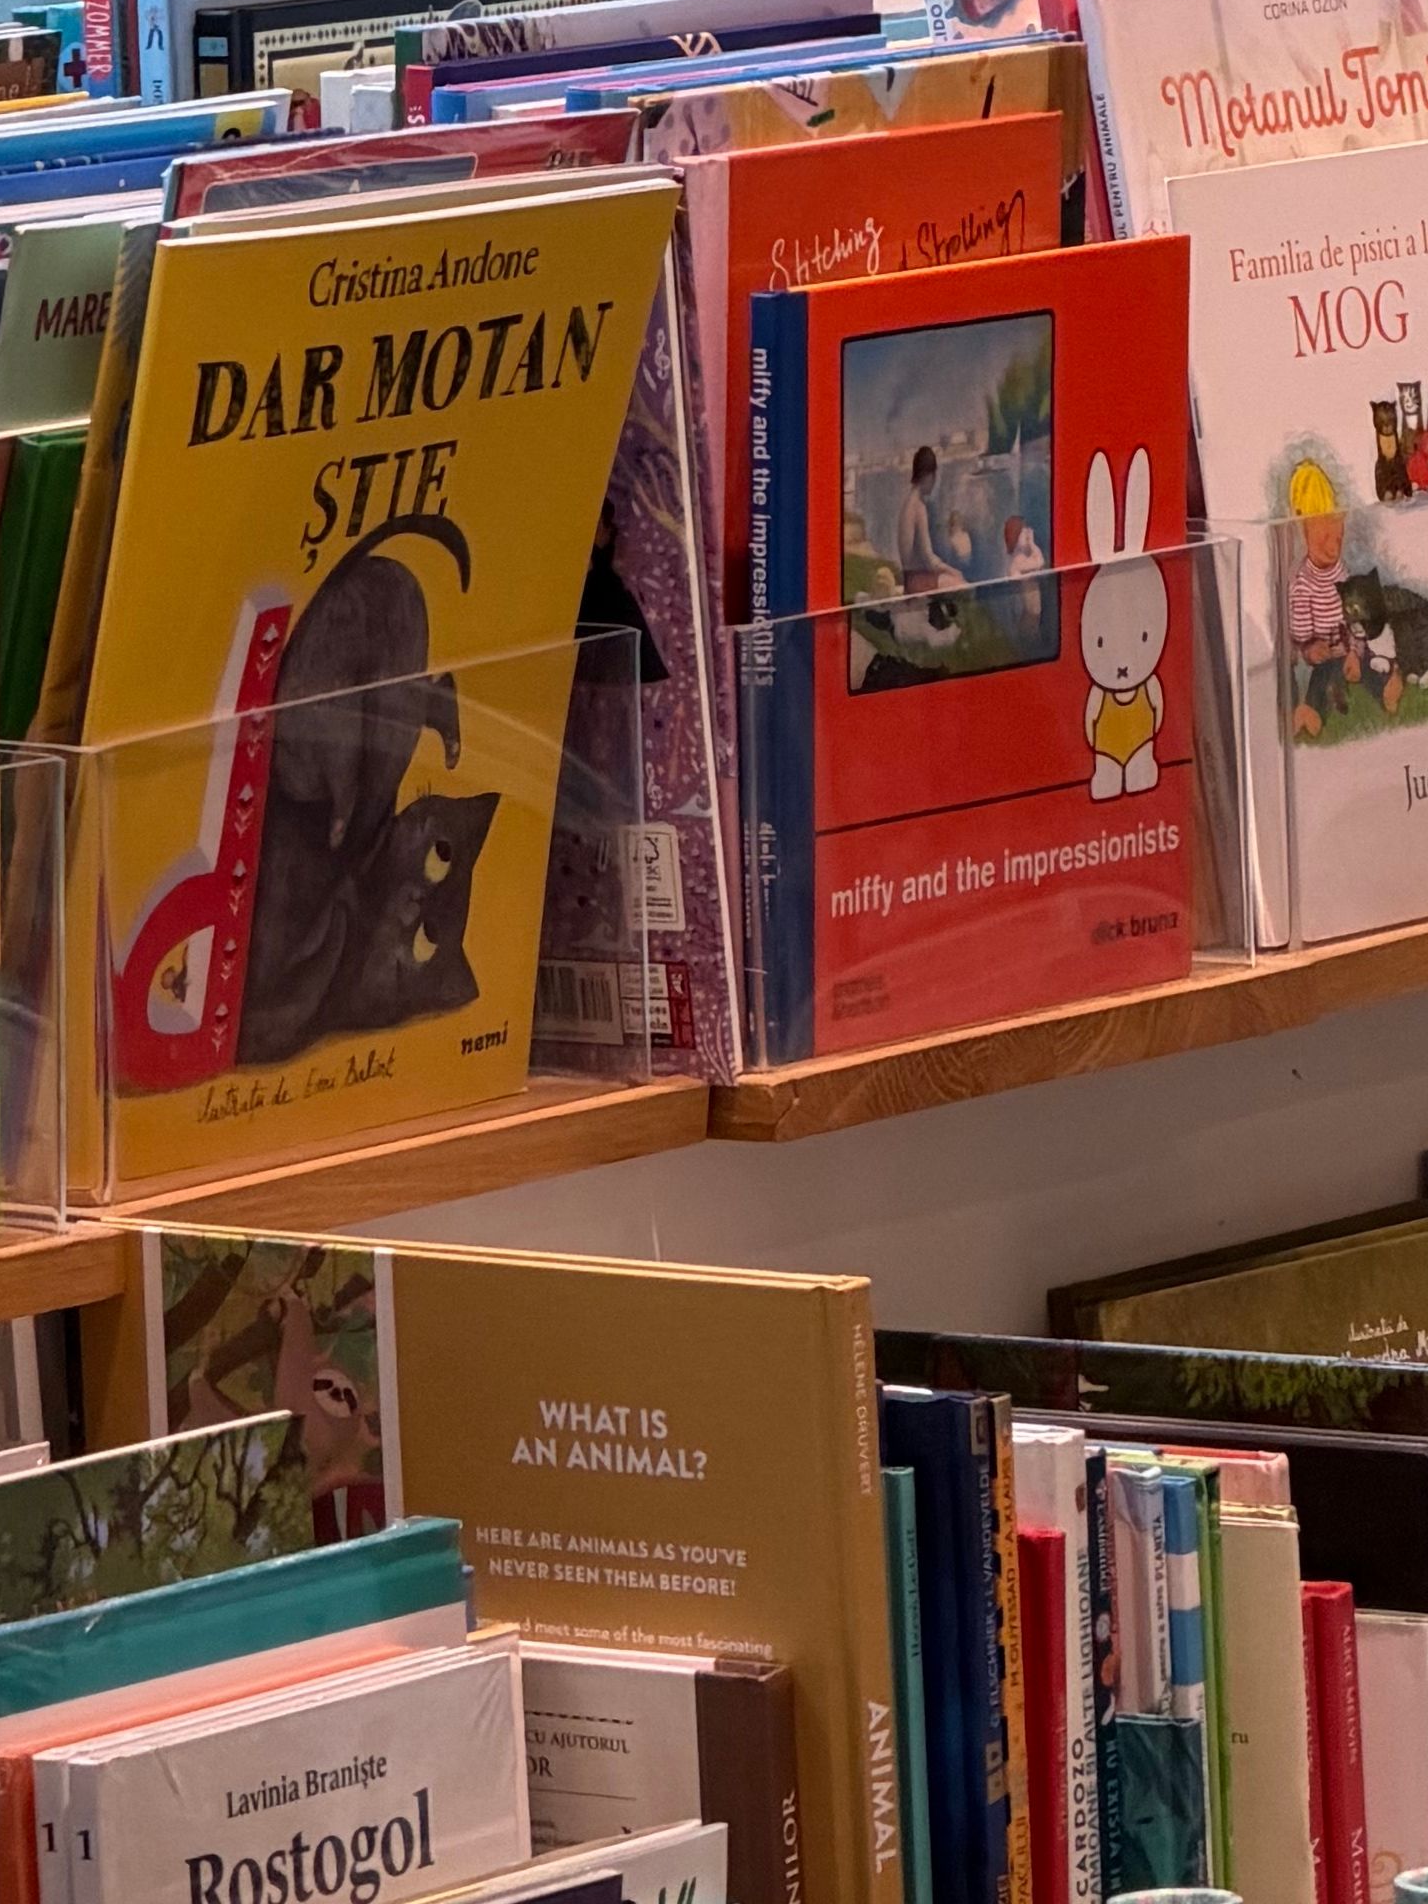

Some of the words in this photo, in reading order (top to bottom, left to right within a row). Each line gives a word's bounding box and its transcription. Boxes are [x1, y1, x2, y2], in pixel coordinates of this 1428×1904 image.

[1161, 65, 1348, 159] Motanul
[309, 254, 426, 310] Cristina
[433, 240, 540, 299] Andone
[771, 216, 884, 292] Stitching
[1229, 238, 1314, 283] Familia
[1320, 234, 1344, 270] de
[1349, 225, 1401, 276] pisici
[1405, 233, 1417, 257] a
[1287, 279, 1409, 358] MOG
[187, 339, 344, 449] DAR
[356, 300, 615, 433] MOTAN
[750, 347, 772, 409] miffy
[751, 415, 771, 460] and
[303, 439, 460, 574] ȘTIE
[751, 467, 771, 506] the
[831, 872, 894, 918] miffy
[902, 862, 947, 904] and
[956, 856, 995, 892] the
[1003, 820, 1180, 887] impressionists
[539, 1400, 631, 1437] WHAT
[639, 1408, 668, 1440] IS
[511, 1437, 558, 1467] AN
[566, 1441, 708, 1481] ANIMAL?
[475, 1527, 523, 1547] HERE
[527, 1531, 563, 1551] ARE
[567, 1534, 649, 1559] ANIMALS
[651, 1542, 675, 1561] AS
[489, 1557, 550, 1580] NEVER
[553, 1563, 600, 1585] SEEN
[603, 1568, 656, 1590] THEM
[659, 1573, 738, 1597] BEFORE!
[613, 1625, 629, 1643] of
[631, 1626, 656, 1644] the
[550, 1733, 631, 1754] AJUTORUL
[225, 1776, 302, 1820] Lavinia
[303, 1751, 389, 1806] Braniște
[867, 1700, 897, 1874] ANIMAL
[1072, 1737, 1089, 1898] CARDOZO
[76, 1828, 94, 1862] 1
[184, 1788, 435, 1904] Rostogol
